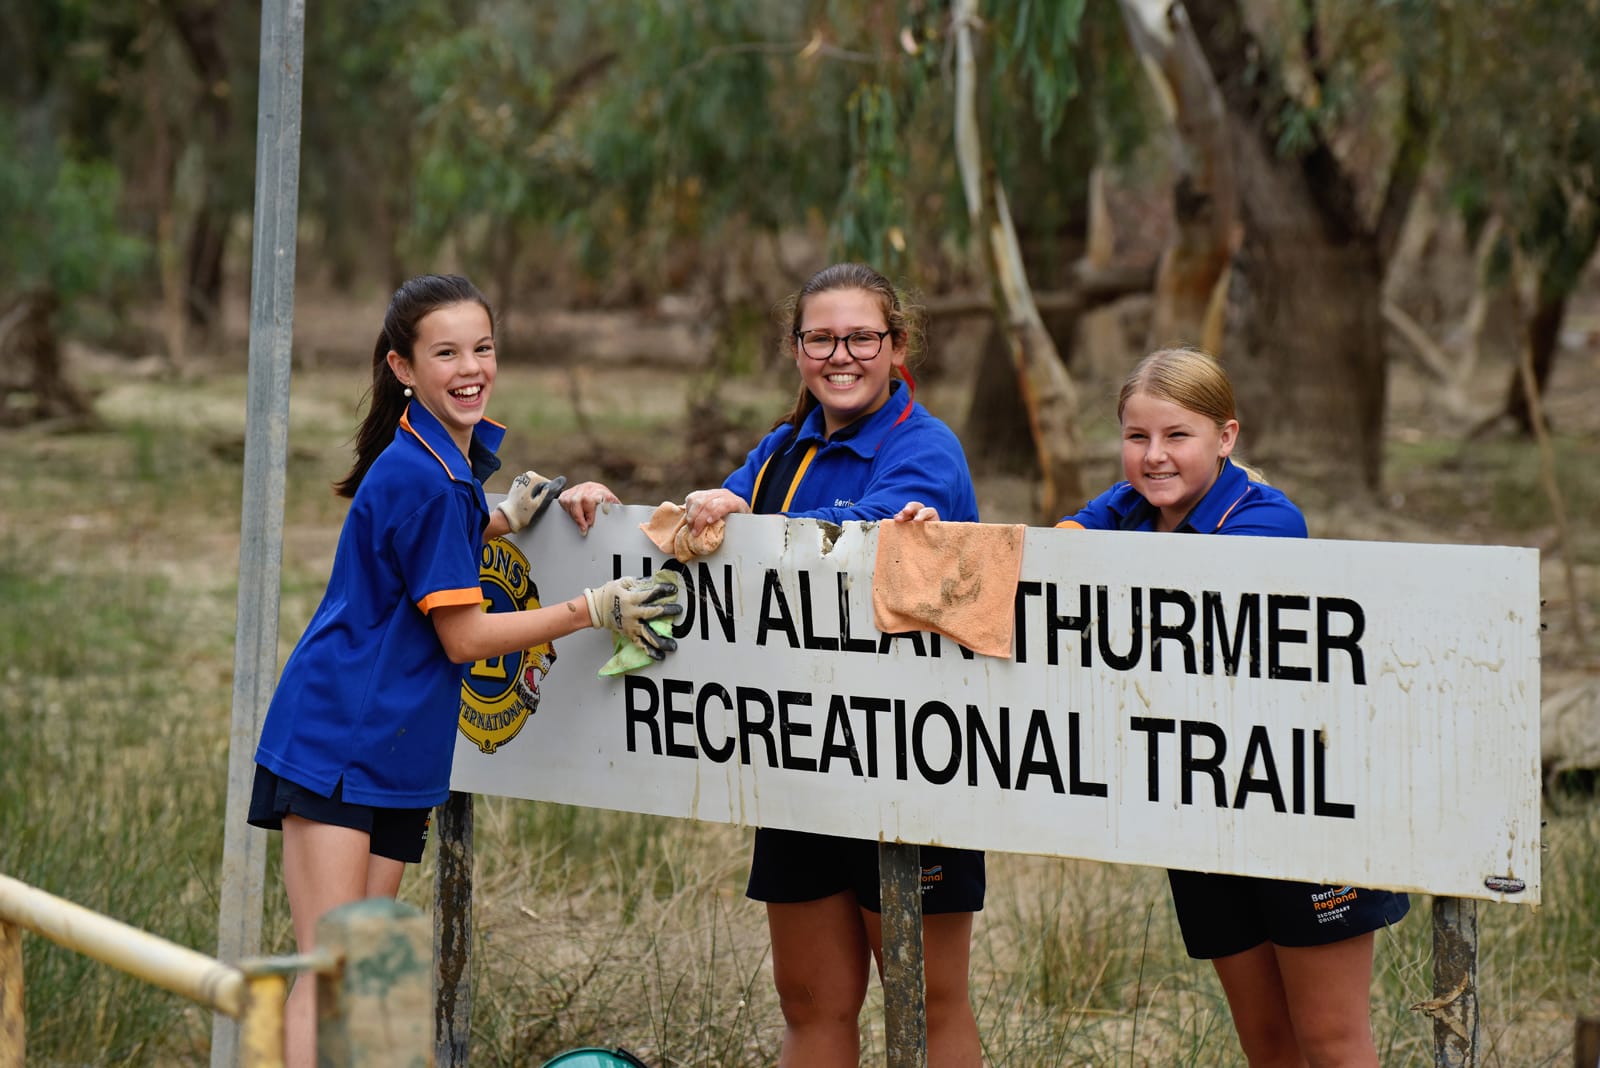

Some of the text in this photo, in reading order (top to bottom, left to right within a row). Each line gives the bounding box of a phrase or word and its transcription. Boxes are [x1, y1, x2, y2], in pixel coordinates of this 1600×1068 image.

[481, 544, 524, 588] ONS
[756, 568, 975, 660] ALL
[1014, 581, 1367, 685] THURMER
[625, 675, 1356, 819] RECREATIONAL TRAIL
[1311, 888, 1335, 901] Berri
[1314, 889, 1358, 910] Regional
